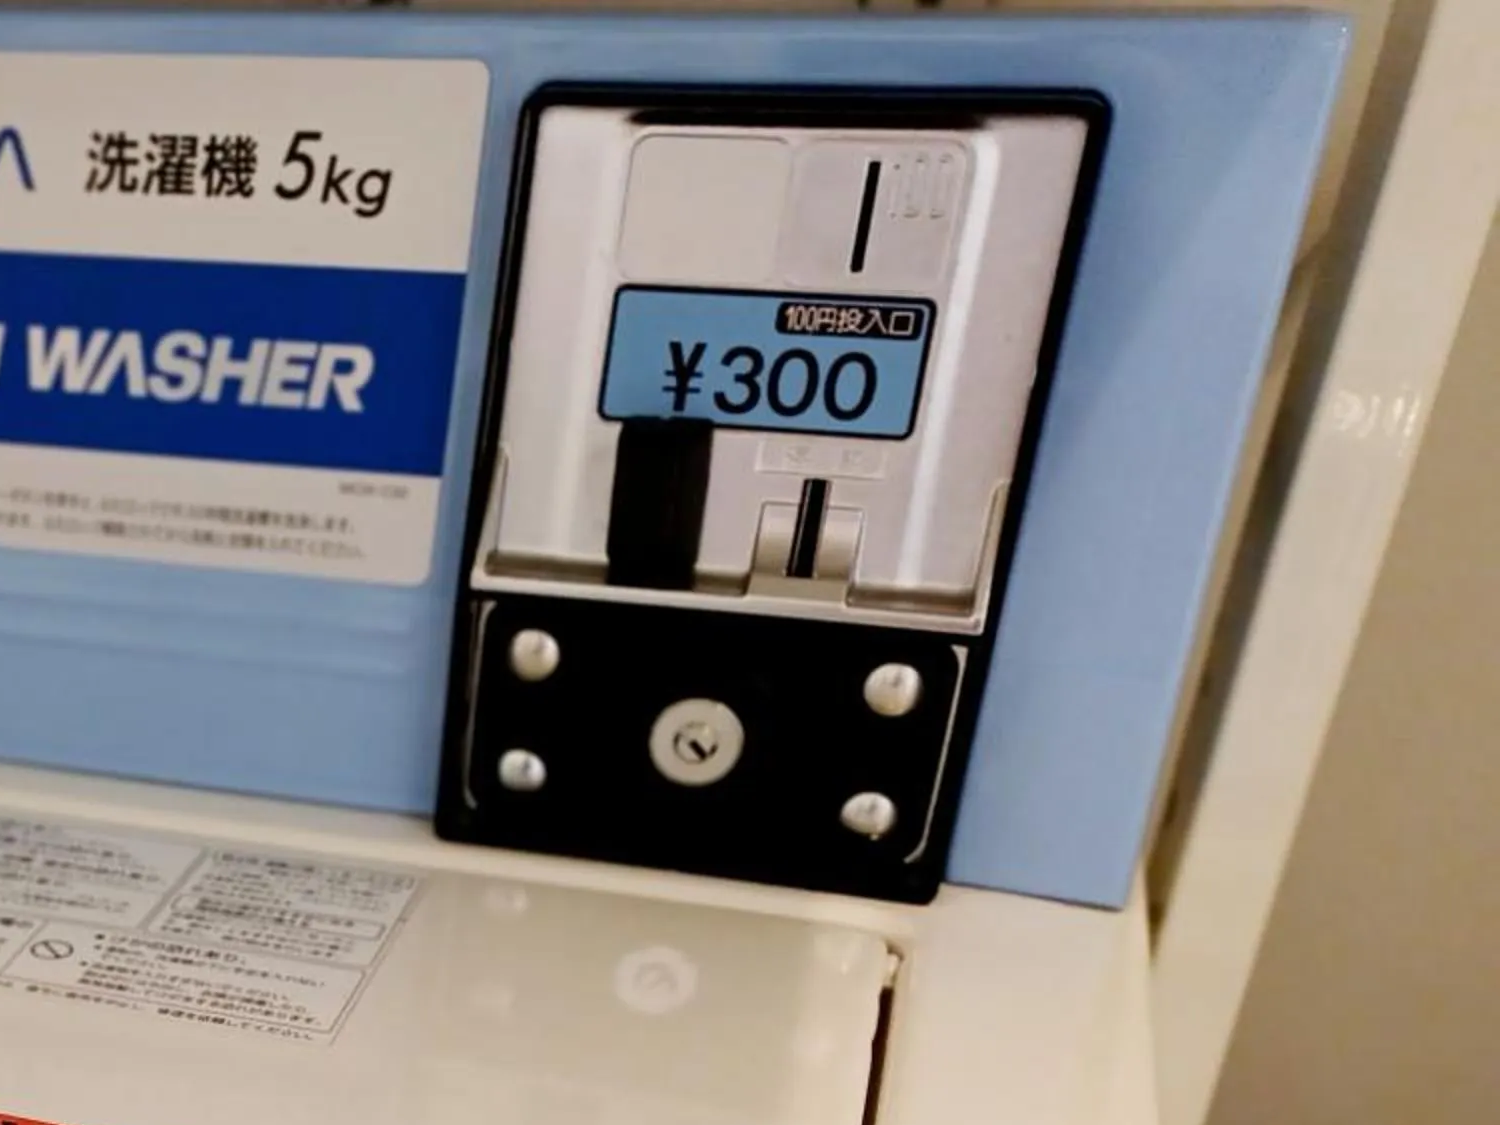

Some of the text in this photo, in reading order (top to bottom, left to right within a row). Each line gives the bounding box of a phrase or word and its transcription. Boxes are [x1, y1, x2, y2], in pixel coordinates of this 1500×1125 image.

[84, 130, 393, 219] 洗濯機 5kg
[784, 305, 915, 336] 100円投入口
[26, 325, 376, 412] WASHER
[661, 340, 879, 421] ¥300
